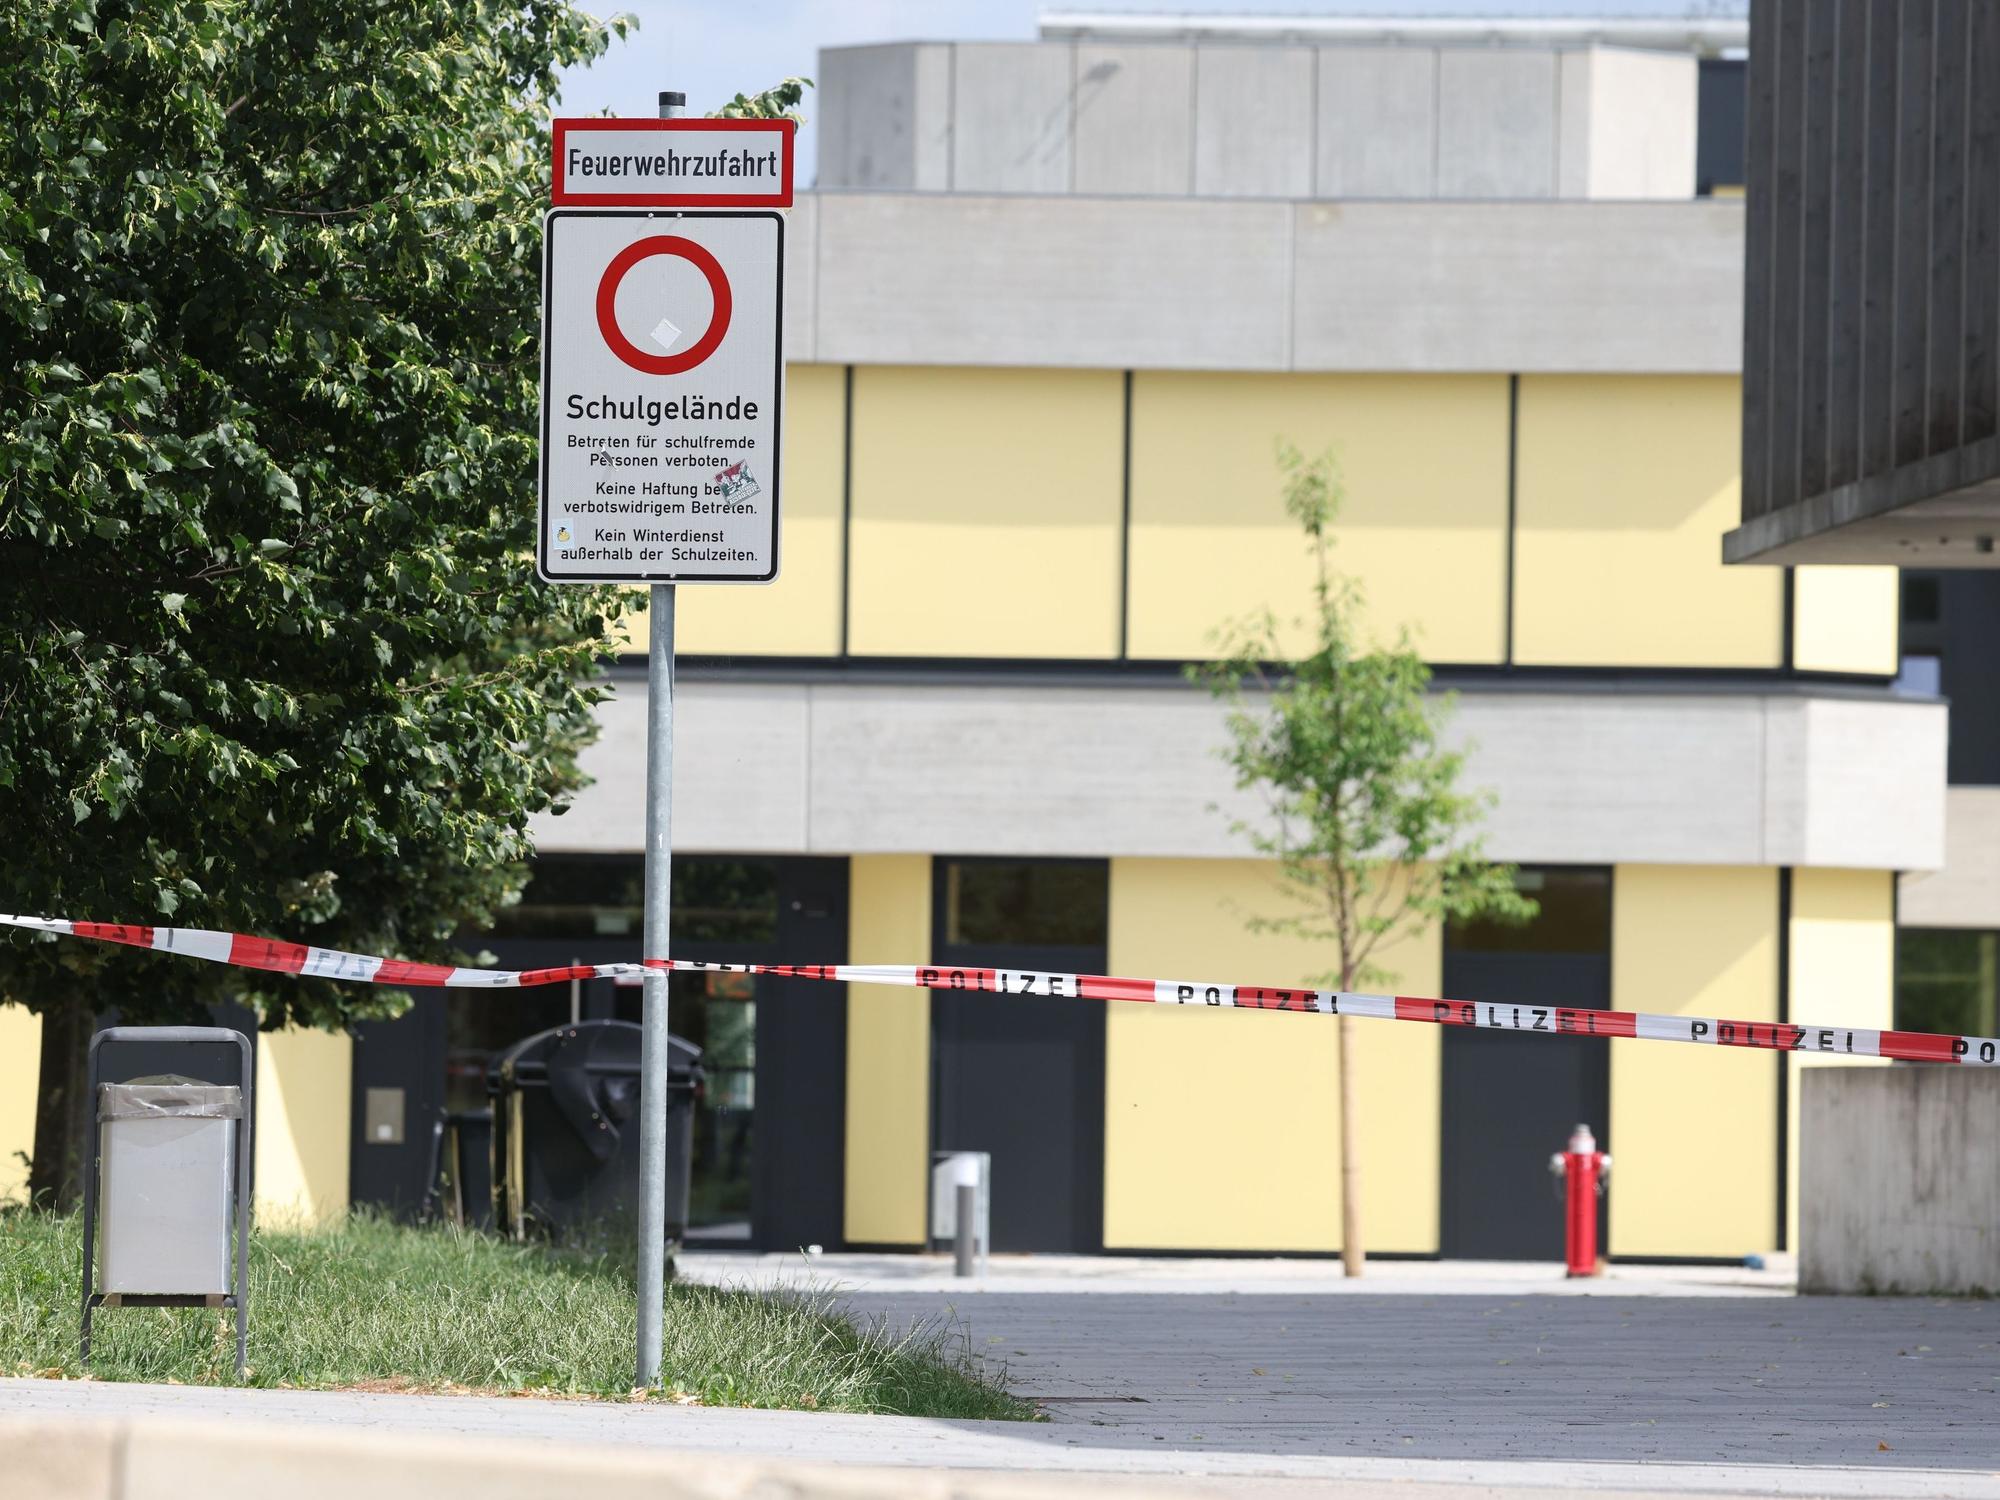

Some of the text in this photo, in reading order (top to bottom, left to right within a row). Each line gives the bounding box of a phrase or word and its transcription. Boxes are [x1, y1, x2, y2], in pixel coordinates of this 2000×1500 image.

[568, 148, 777, 177] Feuerwehrzufahrt
[566, 394, 759, 427] Schulgelände
[567, 434, 756, 449] Betreten für schulfremde
[590, 453, 732, 467] Pesonen verboten.
[596, 481, 636, 495] Keine
[642, 482, 698, 499] Haftung
[563, 500, 685, 517] verbotswidrigem
[595, 528, 724, 543] Kein Winterdienst
[560, 546, 759, 561] außerhalb der Schulzeiten.
[922, 969, 1082, 998] POLIZEI
[1177, 985, 1339, 1014] POLIZEI
[1433, 1002, 1595, 1033] POLIZEI
[1691, 1020, 1853, 1053] POLIZEI
